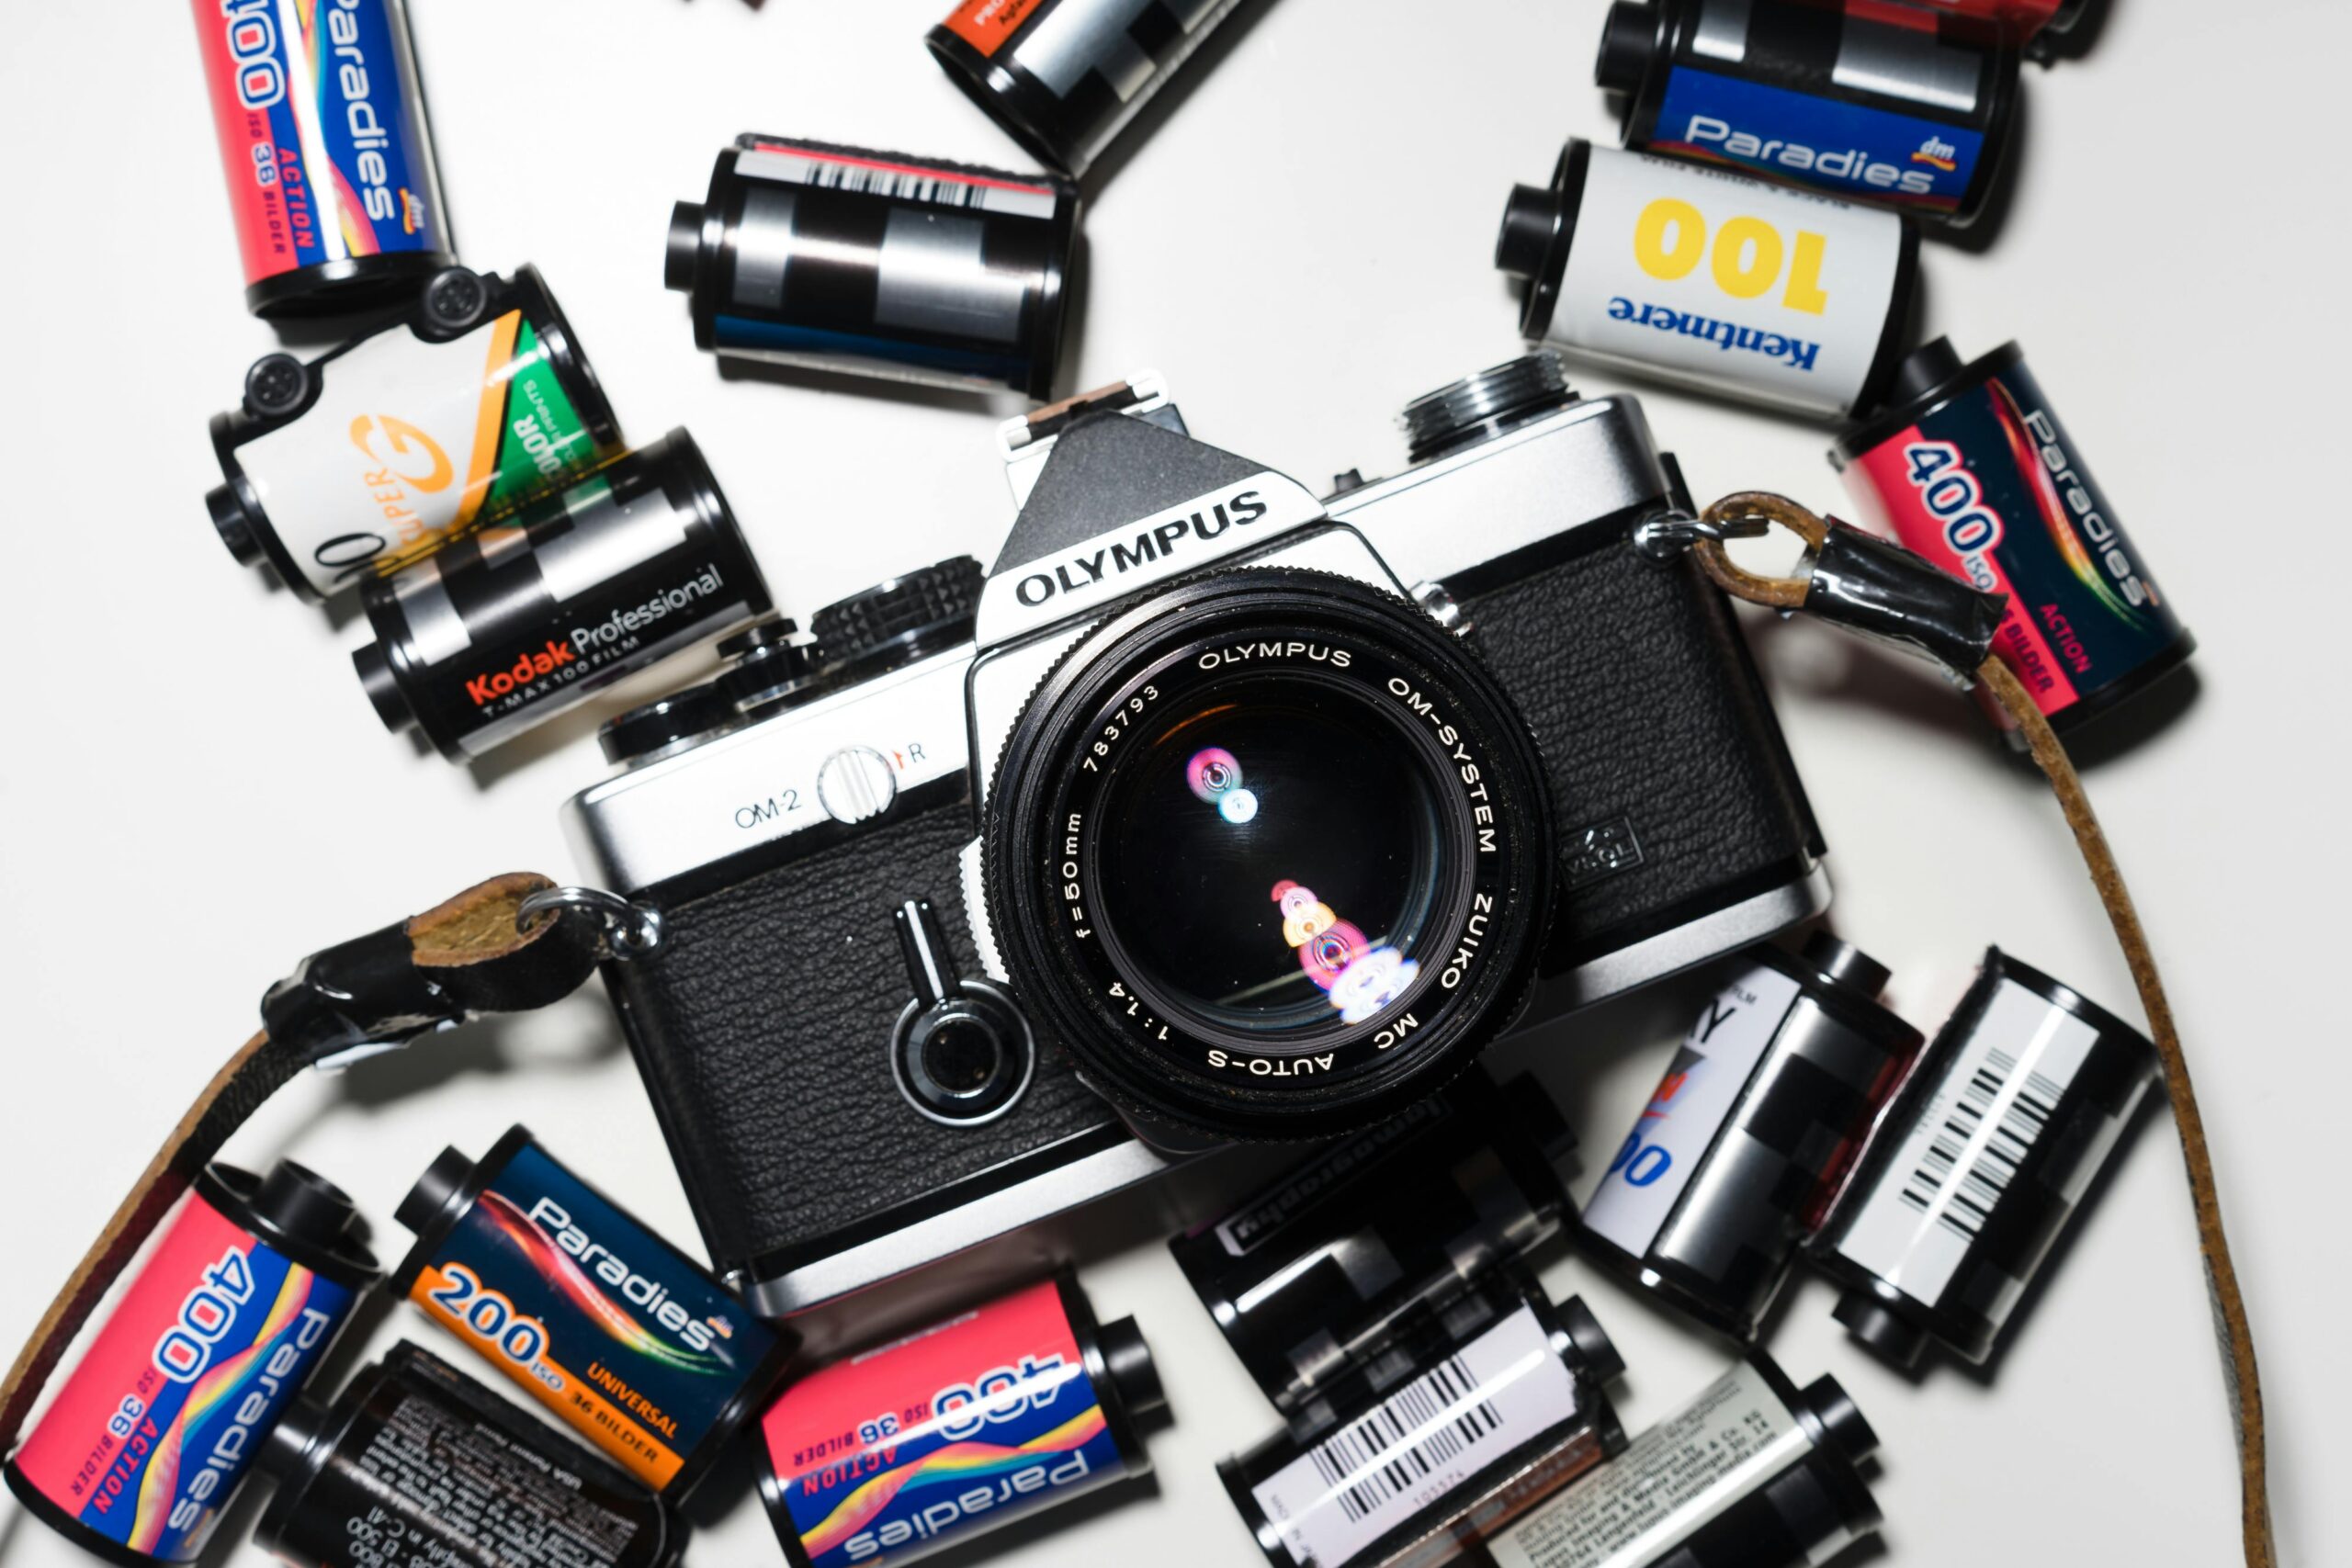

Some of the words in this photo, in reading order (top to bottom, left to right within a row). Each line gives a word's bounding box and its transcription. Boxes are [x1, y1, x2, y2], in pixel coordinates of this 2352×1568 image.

[247, 113, 263, 138] ISO
[328, 0, 395, 220] aradies
[251, 141, 277, 186] 36
[1685, 114, 1935, 196] Paradies
[1920, 136, 1956, 161] dm
[264, 191, 287, 254] BILDER
[278, 148, 314, 248] ACTION
[1634, 197, 1829, 316] 100
[1608, 296, 1820, 372] Kentmere
[1904, 442, 2003, 557] 400
[2025, 410, 2147, 607] Paradies
[1015, 490, 1268, 607] OLYMPUS
[1962, 551, 1997, 592] ISO
[465, 639, 575, 705] Kodak
[571, 564, 725, 653] Professional
[1198, 641, 1352, 671] OLYMPUS
[2005, 623, 2055, 694] BILDER
[2041, 604, 2092, 674] ACTION
[481, 680, 550, 718] T-MAX
[554, 661, 590, 690] 100
[592, 636, 640, 666] FILM
[909, 740, 926, 762] R
[1083, 683, 1159, 773] 783793
[1387, 676, 1498, 853] OM-SYSTEM
[735, 790, 802, 829] OM-2
[1061, 811, 1091, 939] f=50mm
[1441, 893, 1493, 990] ZUIKO
[1108, 980, 1169, 1042] 1:1.4
[1373, 1013, 1419, 1050] MC
[1206, 1048, 1335, 1077] AUTO-S
[527, 1197, 715, 1352] Paradies
[153, 1245, 256, 1383] 400
[427, 1262, 546, 1367] 200
[530, 1360, 565, 1393] ISO
[108, 1393, 145, 1438] 36
[138, 1365, 159, 1395] ISO
[587, 1361, 679, 1439] UNIVERSAL
[904, 1403, 929, 1424] ISO
[932, 1352, 1066, 1440] 400
[168, 1307, 330, 1531] Paradies
[569, 1390, 594, 1416] 36
[594, 1409, 660, 1464] BILDER
[794, 1430, 855, 1468] BILDER
[858, 1412, 901, 1445] 36
[71, 1435, 115, 1497] BILDER
[95, 1416, 161, 1515] ACTION
[802, 1445, 897, 1497] ACTION
[843, 1450, 1091, 1561] Paradies
